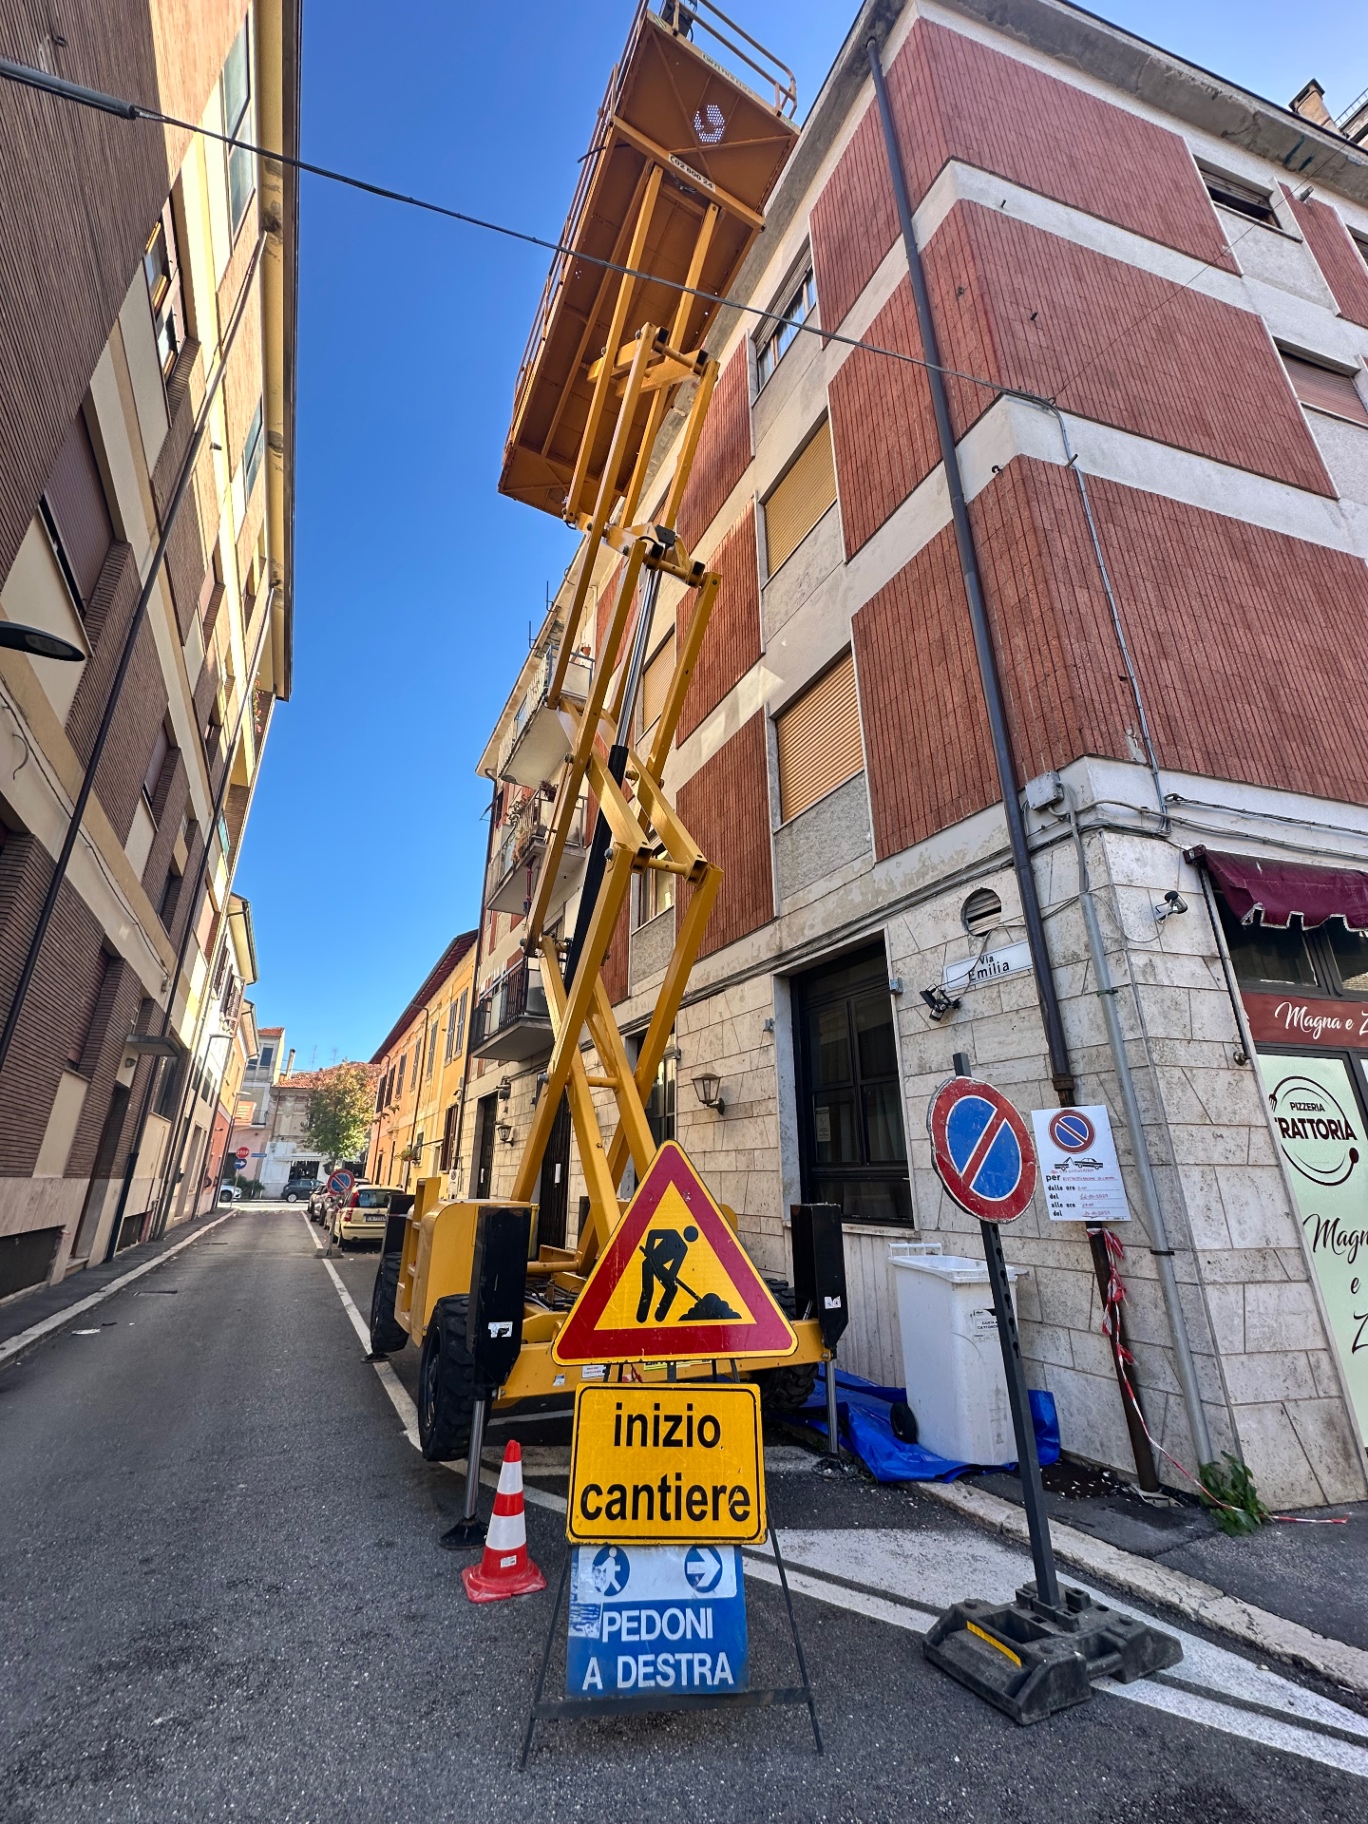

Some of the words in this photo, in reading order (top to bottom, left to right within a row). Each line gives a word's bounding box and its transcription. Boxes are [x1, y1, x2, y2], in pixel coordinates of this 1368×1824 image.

[968, 961, 1010, 981] Emilia
[979, 955, 994, 965] Via
[1274, 1001, 1342, 1040] Magna
[1345, 1018, 1354, 1030] e
[1289, 1102, 1326, 1113] PIZZERIA
[1274, 1116, 1358, 1141] RATTORIA
[1046, 1174, 1061, 1182] per
[1350, 1277, 1360, 1294] e
[614, 1402, 721, 1449] inizio
[580, 1472, 751, 1522] cantiere
[602, 1607, 713, 1643] PEDONI
[582, 1656, 603, 1690] A
[617, 1652, 734, 1689] DESTRA
